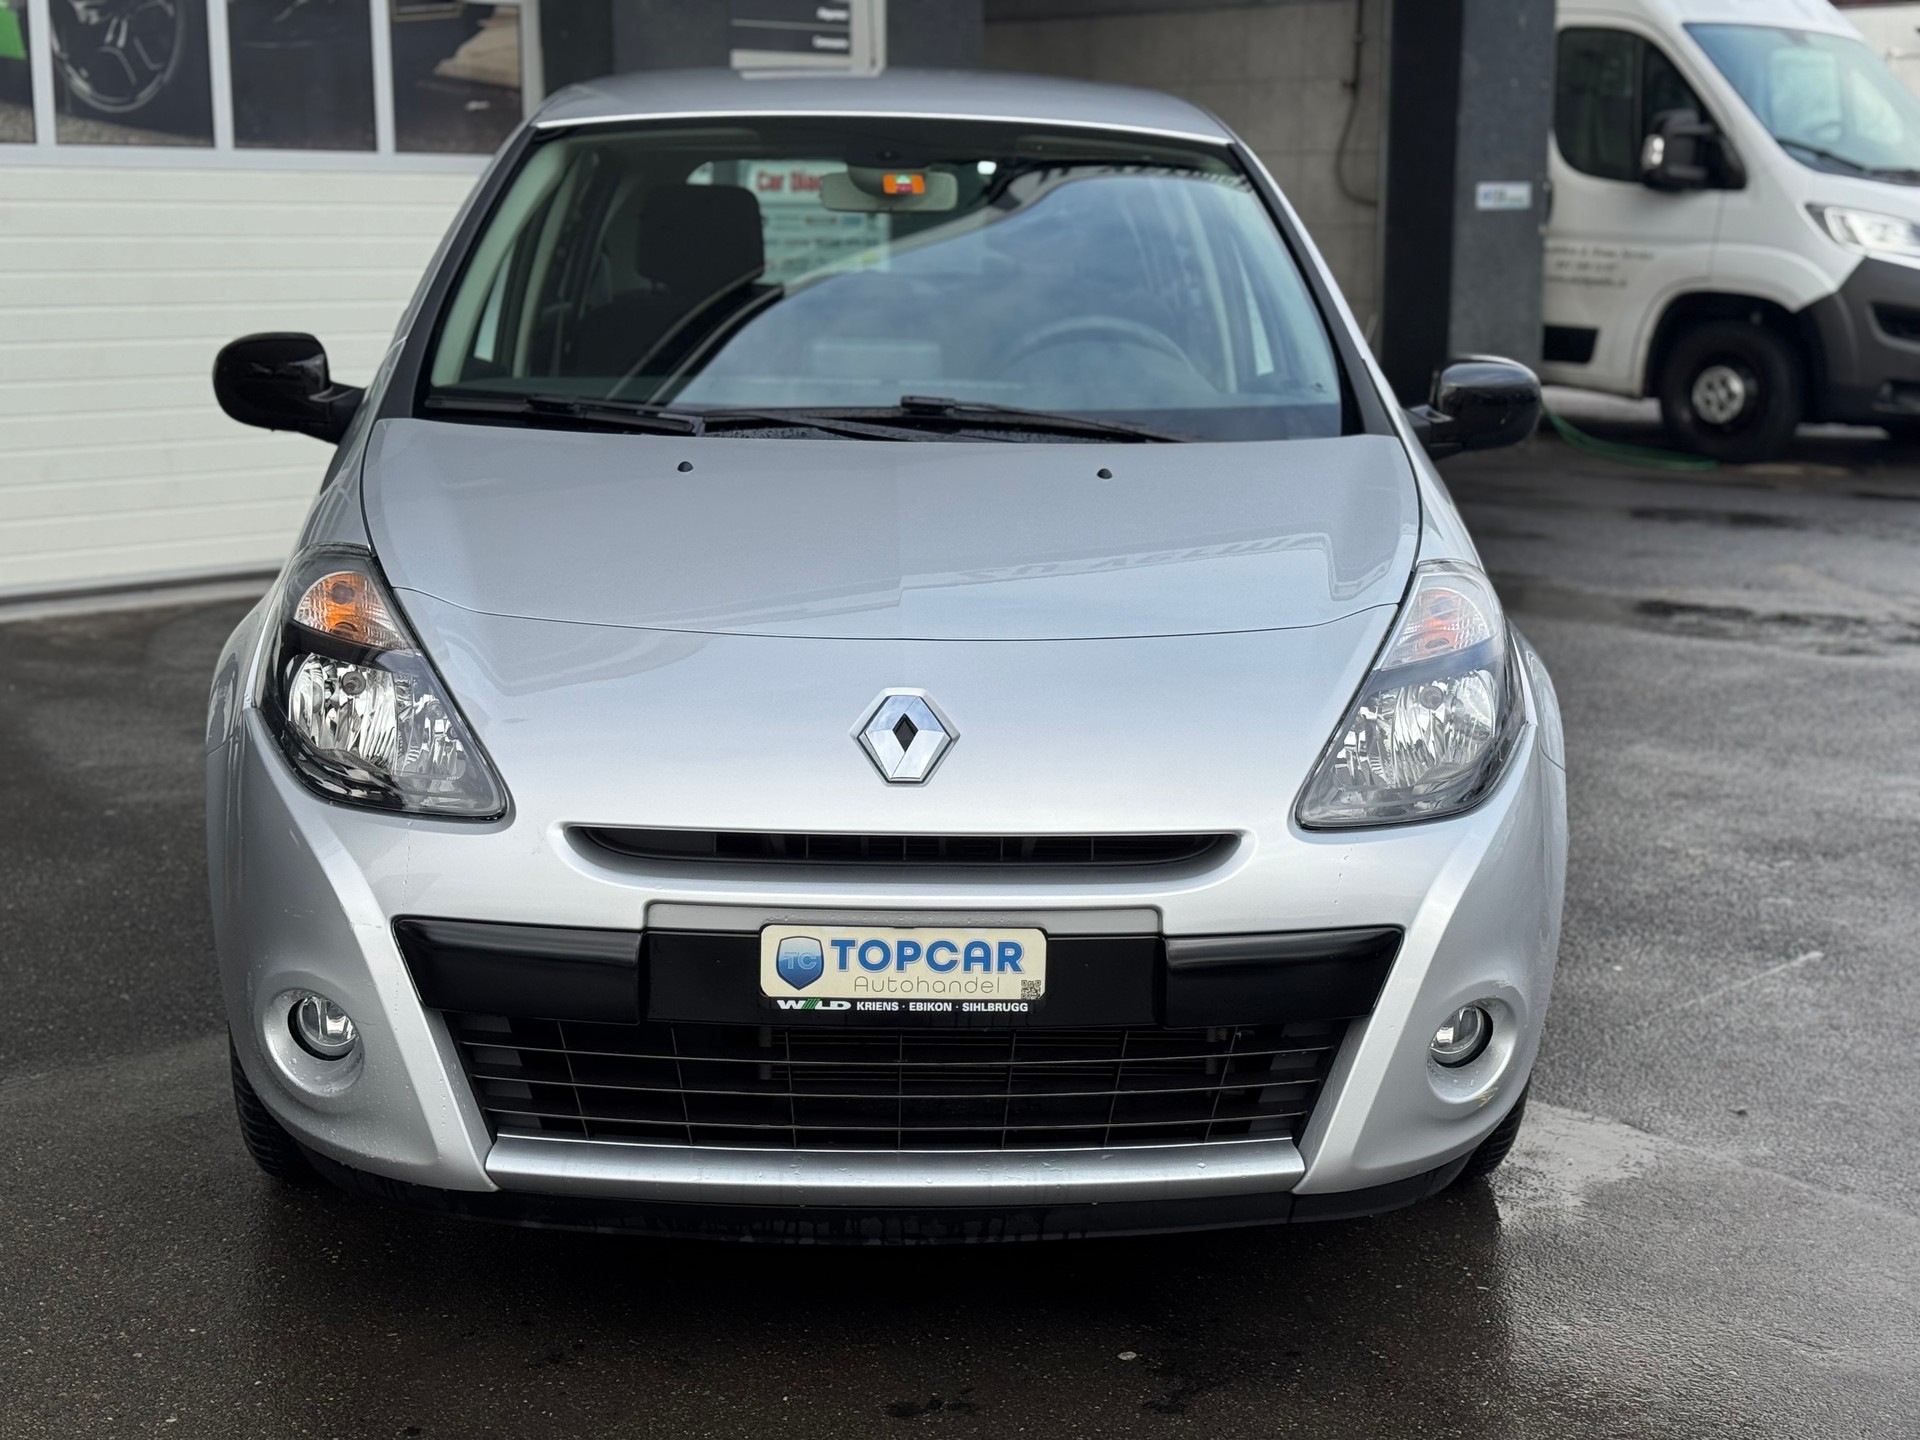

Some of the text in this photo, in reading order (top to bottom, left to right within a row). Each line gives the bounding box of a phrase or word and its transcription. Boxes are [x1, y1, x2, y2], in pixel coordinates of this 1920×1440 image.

[784, 951, 817, 970] TC
[830, 938, 1024, 973] TOPCAR
[854, 975, 1000, 994] Autohandel
[856, 1001, 1028, 1012] KRIENS EBIKON SIHLBRUGG
